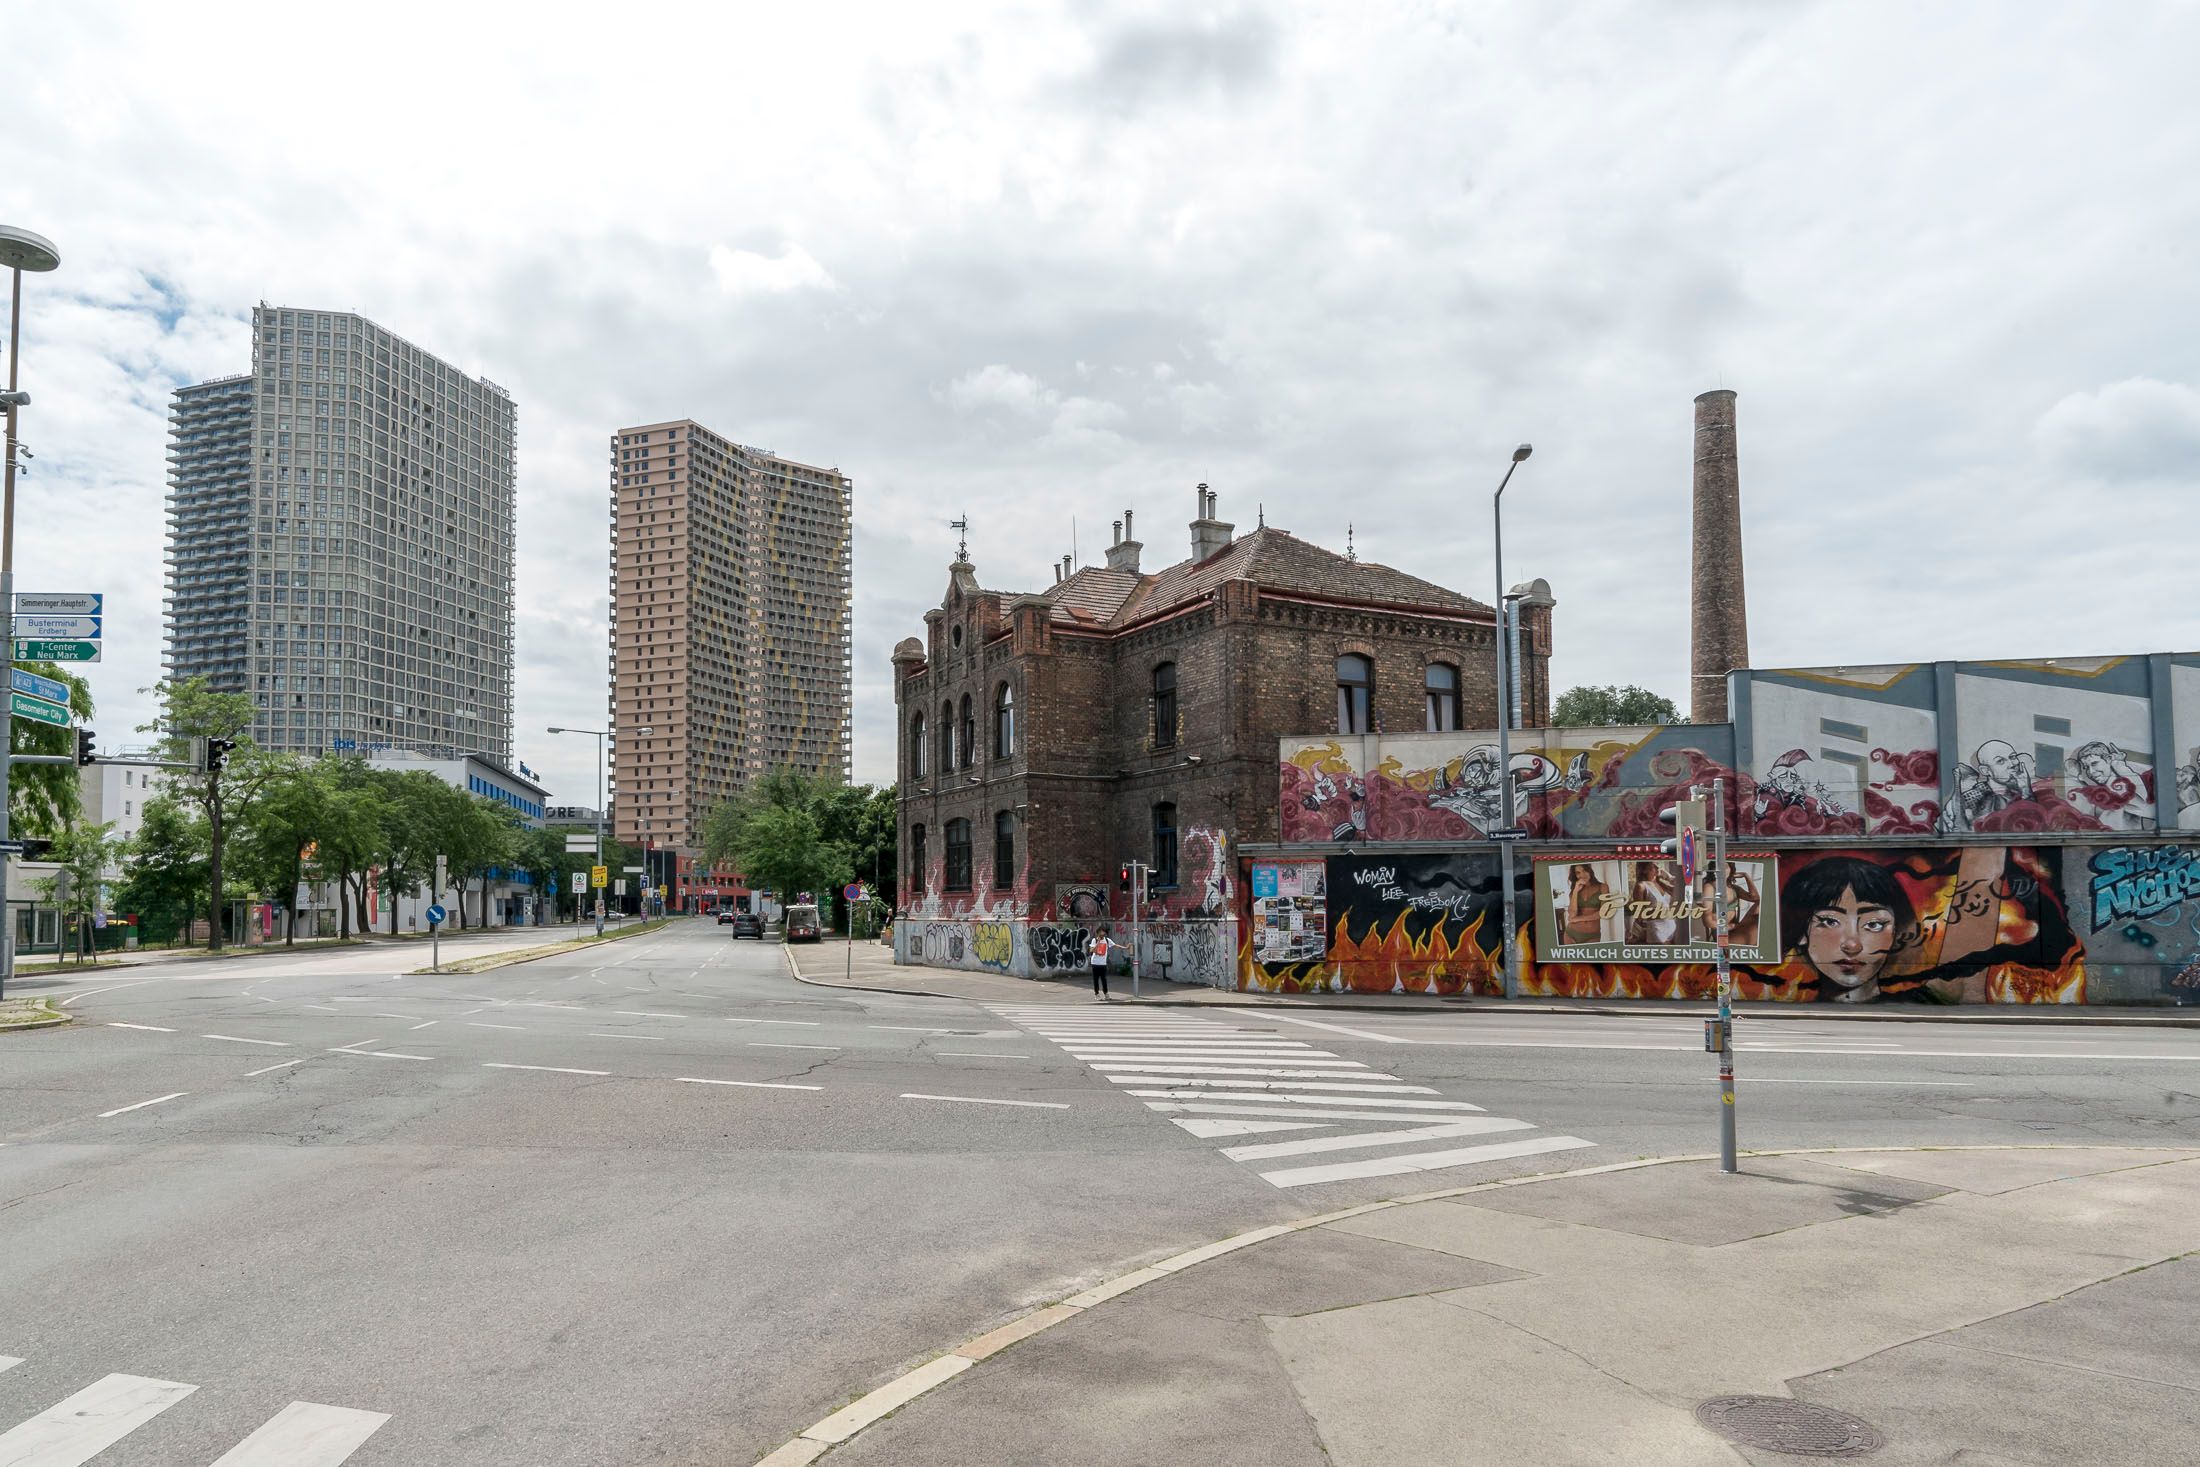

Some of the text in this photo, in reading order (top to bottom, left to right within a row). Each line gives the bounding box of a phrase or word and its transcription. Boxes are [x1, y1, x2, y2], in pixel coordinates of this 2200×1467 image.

[28, 619, 78, 627] Busterminal
[40, 643, 77, 651] T-Center
[37, 651, 79, 659] Neu Marx
[16, 700, 63, 721] Gasometer City
[334, 738, 356, 750] ibis
[1353, 866, 1396, 888] WOMAN
[1382, 886, 1409, 901] LIFE
[1629, 901, 1708, 920] Tchibo
[1550, 949, 1764, 960] WIRKLICH GUTES ENTDEKEN.
